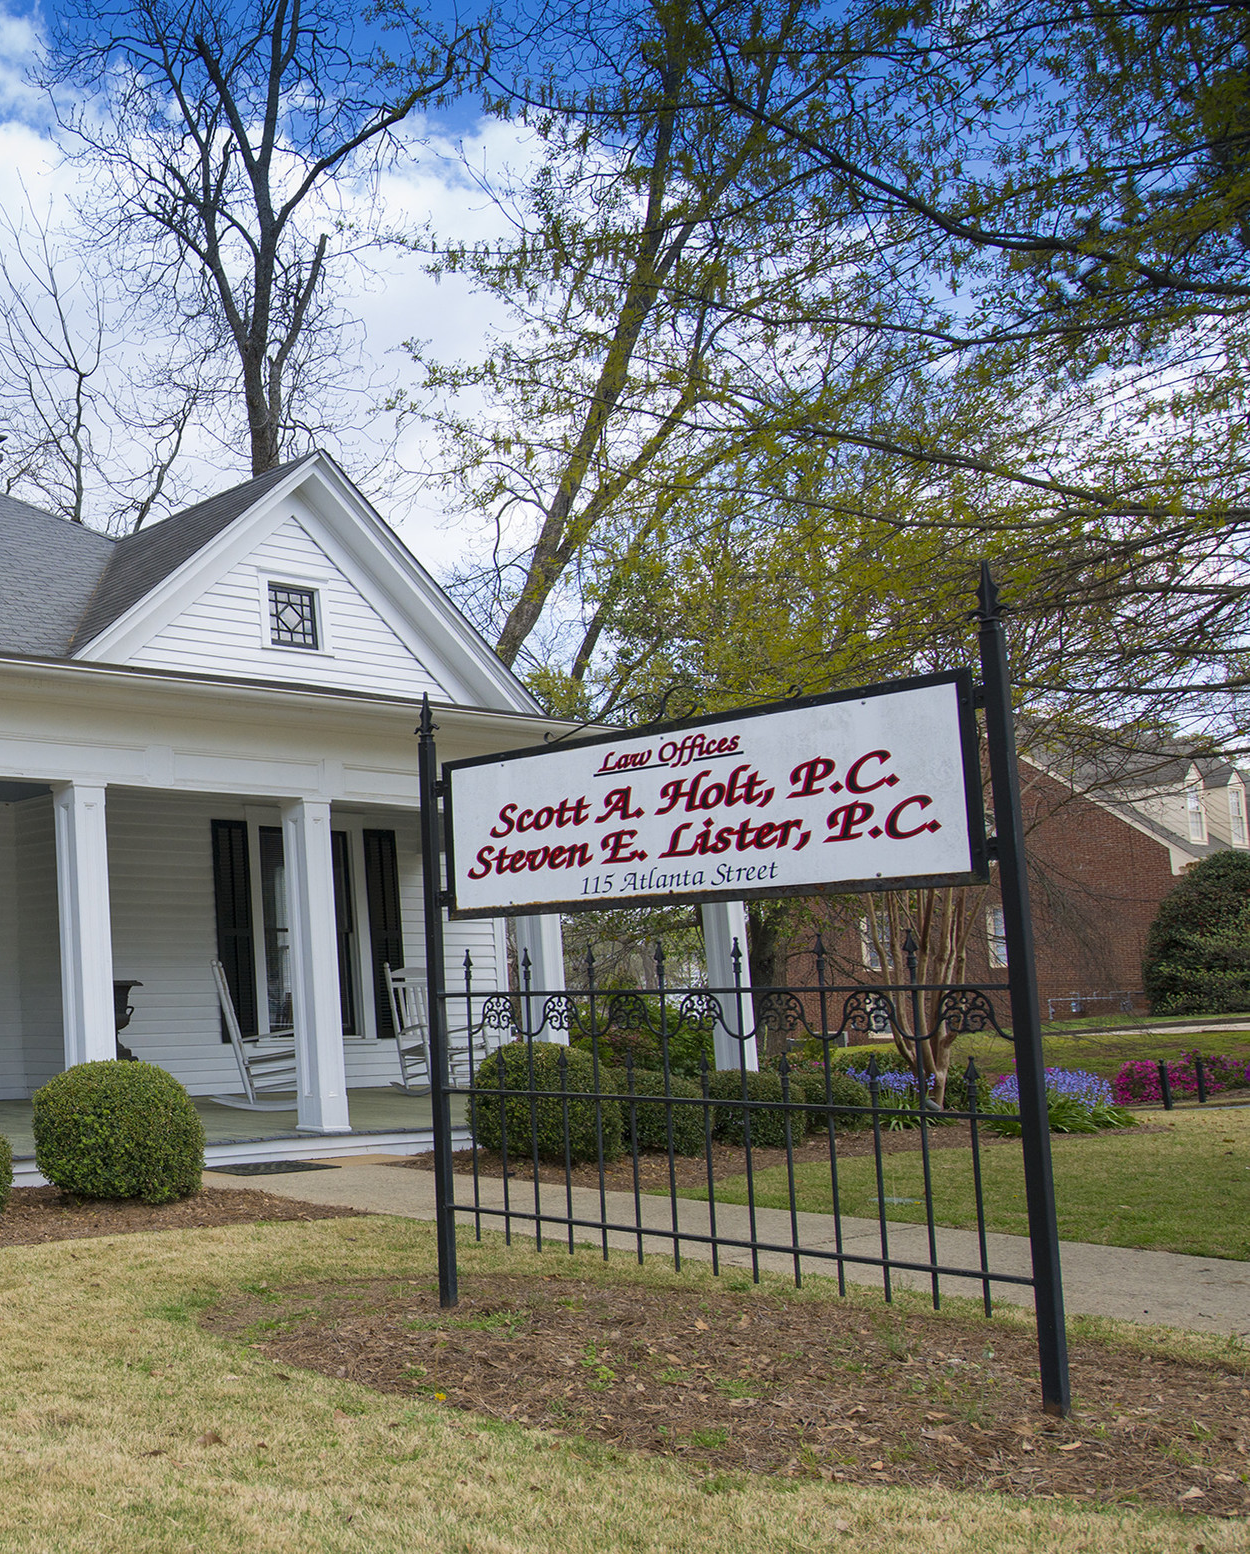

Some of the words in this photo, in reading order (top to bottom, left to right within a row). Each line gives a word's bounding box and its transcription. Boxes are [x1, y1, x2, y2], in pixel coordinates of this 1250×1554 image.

[598, 748, 651, 772] Law
[658, 733, 740, 767] Offices
[490, 796, 592, 839] Scott
[594, 785, 645, 824] A.
[654, 764, 775, 816] Holt,
[785, 749, 900, 799] P.C.
[467, 842, 594, 880] Steven
[600, 829, 648, 865] E.
[658, 817, 812, 859] Lister,
[822, 795, 942, 844] P.C.
[580, 872, 616, 895] 115
[619, 866, 704, 892] Atlanta
[710, 862, 778, 886] Street
